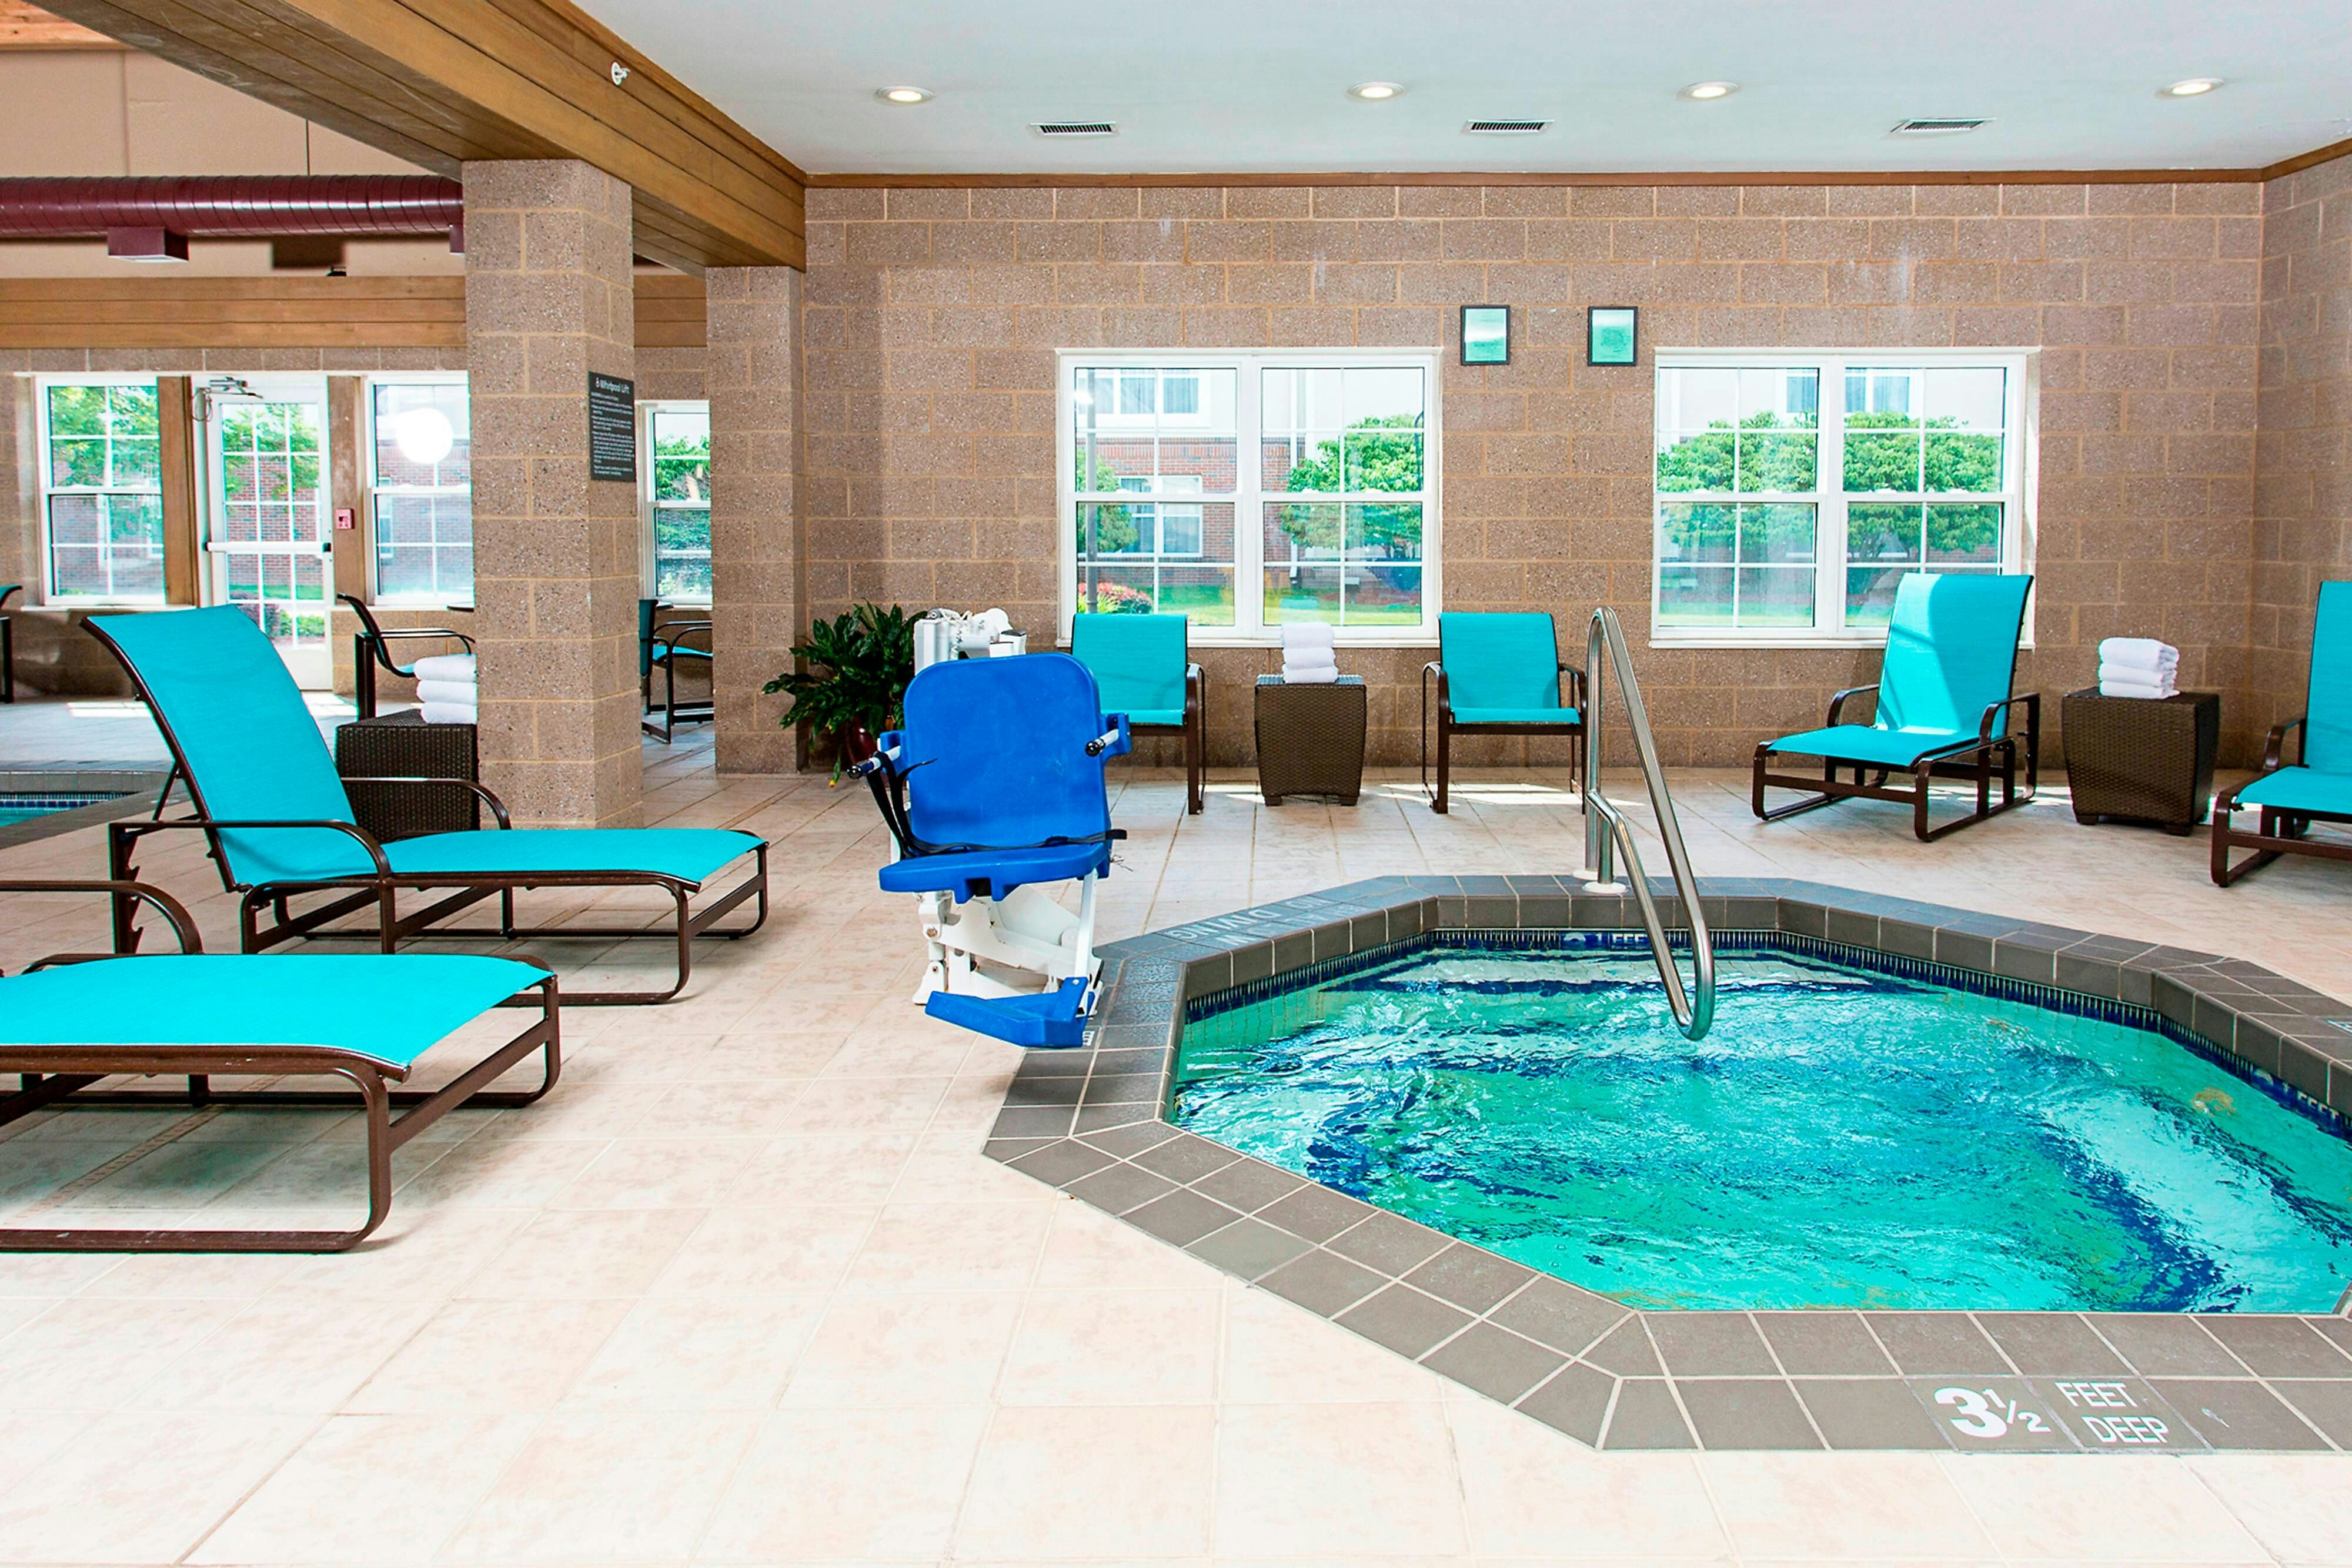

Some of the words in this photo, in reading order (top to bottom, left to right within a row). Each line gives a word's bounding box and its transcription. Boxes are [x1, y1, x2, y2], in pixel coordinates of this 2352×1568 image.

[600, 379, 621, 393] Whirlpool
[622, 383, 630, 394] Lift
[1286, 895, 1332, 909] NO
[1170, 909, 1282, 940] DIVING
[2054, 1382, 2137, 1407] FEET
[2081, 1415, 2170, 1443] DEEP
